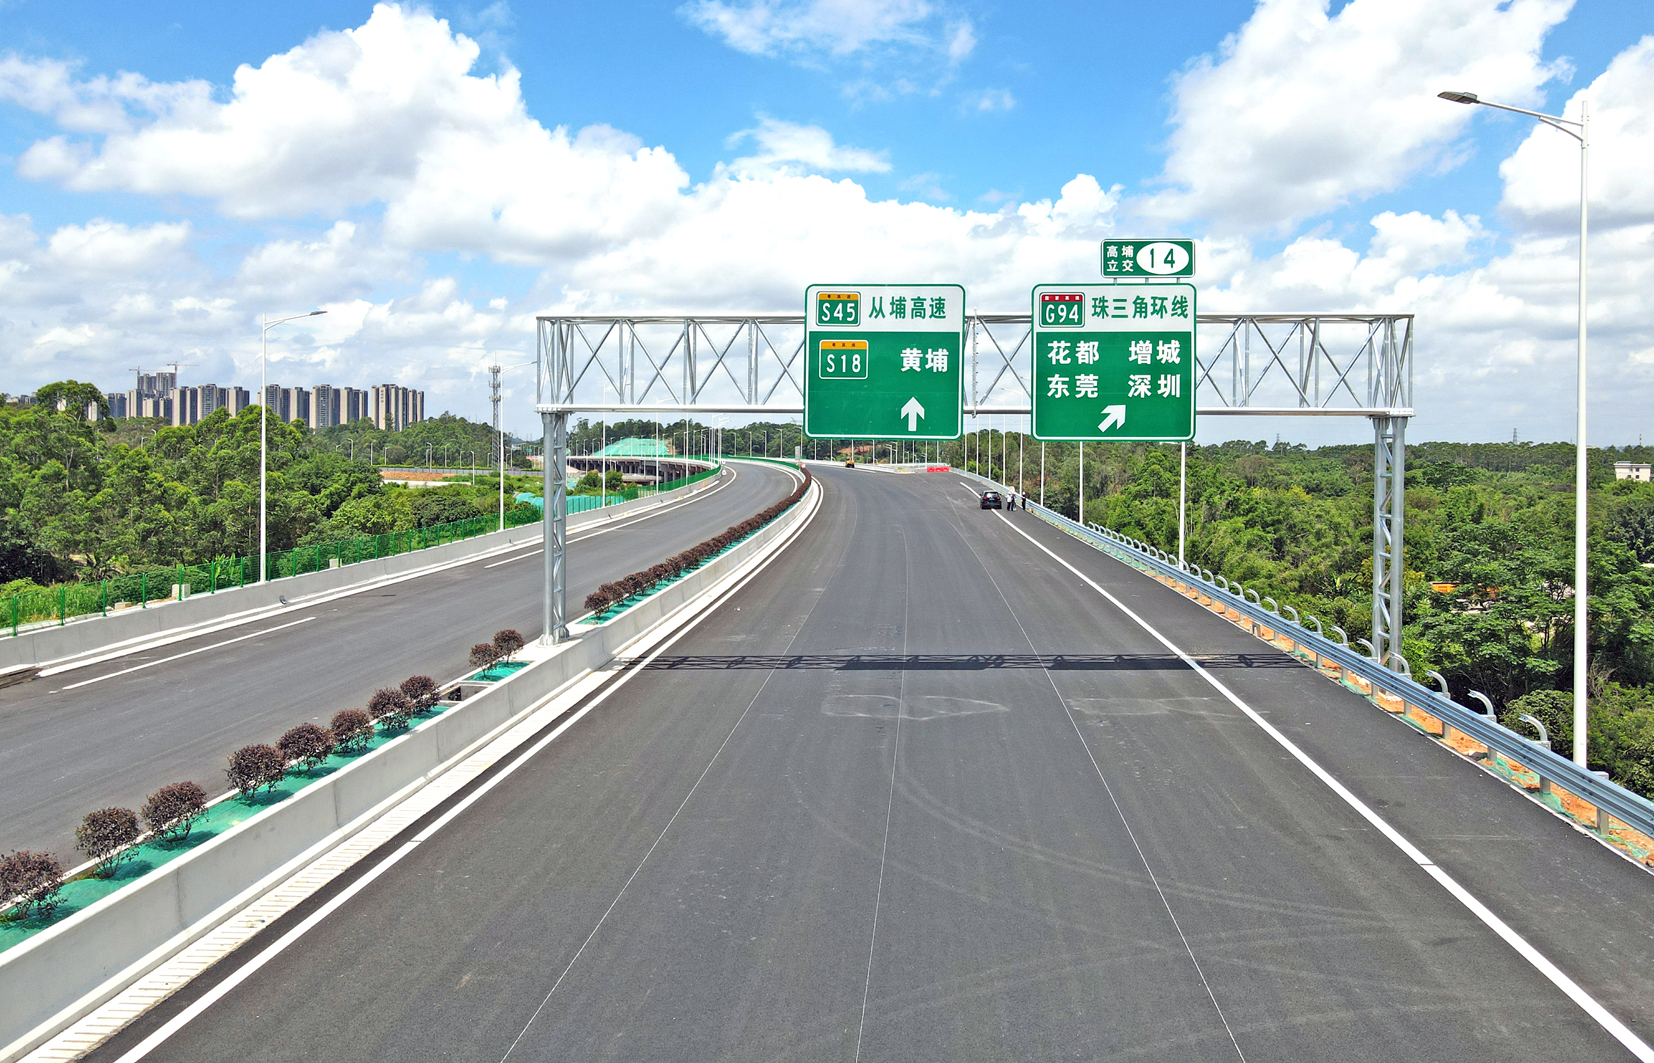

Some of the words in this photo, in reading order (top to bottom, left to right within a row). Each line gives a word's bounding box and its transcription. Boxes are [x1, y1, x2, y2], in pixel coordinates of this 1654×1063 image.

[1106, 245, 1134, 258] 高埔
[1150, 248, 1175, 269] 14
[1106, 260, 1134, 272] 立交
[821, 302, 856, 321] S45
[868, 296, 947, 319] 从埔高速
[1045, 304, 1079, 323] G94
[1091, 295, 1189, 319] 珠三角环线
[900, 347, 949, 373] 黄埔
[1047, 340, 1100, 365] 花都
[1128, 339, 1181, 365] 增城
[826, 354, 861, 373] S18
[1047, 373, 1099, 399] 东莞
[1127, 374, 1181, 399] 深圳
